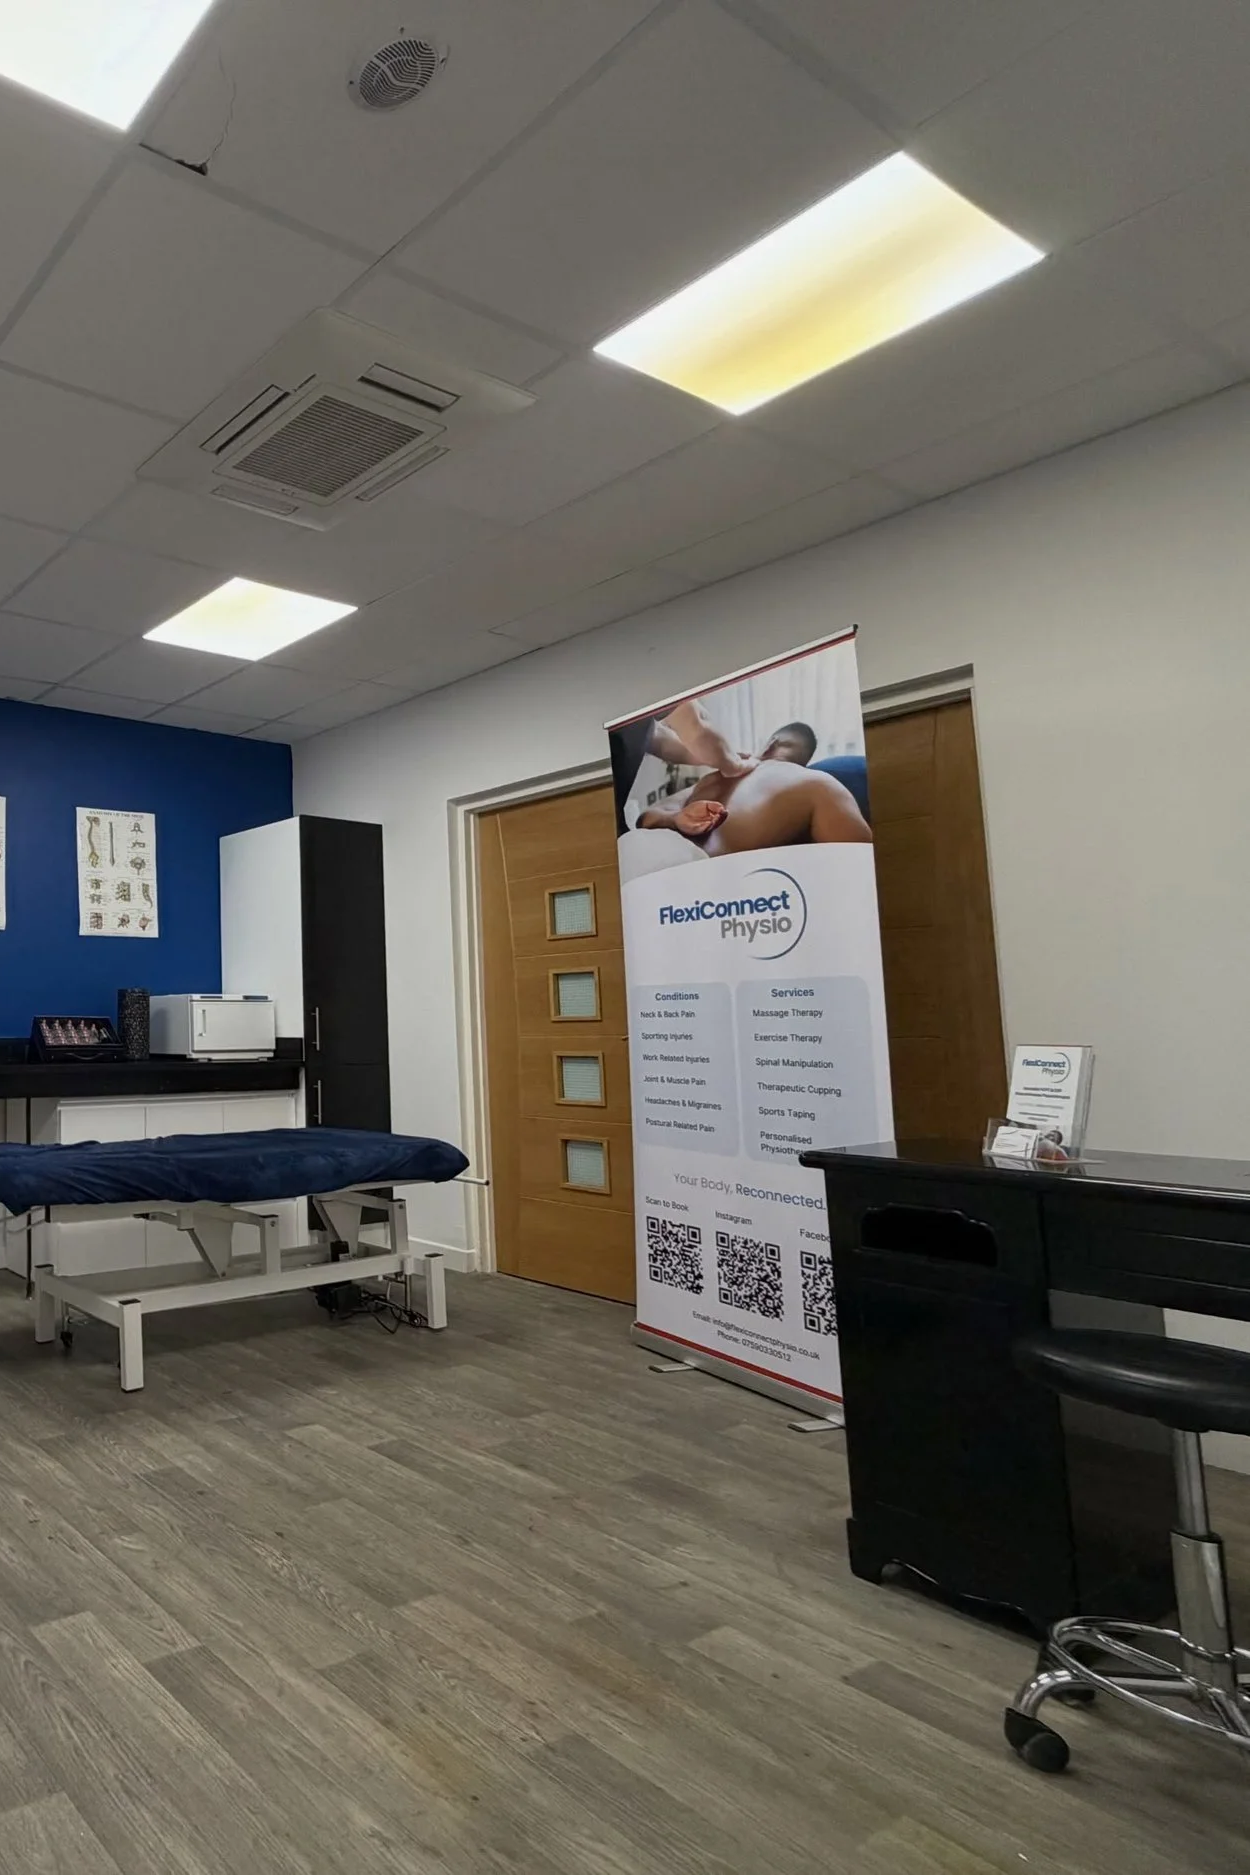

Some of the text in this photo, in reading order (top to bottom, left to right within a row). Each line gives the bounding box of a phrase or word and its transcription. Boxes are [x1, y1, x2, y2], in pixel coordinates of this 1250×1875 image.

[660, 890, 790, 924] FlexiConnect
[721, 912, 792, 943] Physio
[655, 992, 699, 1001] Conditions
[771, 988, 814, 997] Services
[752, 1009, 823, 1018] Massage Therapy
[641, 1032, 693, 1041] Sporting Injuries
[754, 1033, 822, 1044] Exercise Therapy
[686, 1055, 710, 1064] Injuries
[755, 1058, 833, 1069] Spinal Manipulation
[667, 1076, 690, 1085] Muscle
[758, 1082, 842, 1097] Therapeutic Cupping
[645, 1096, 680, 1107] Headaches
[688, 1100, 722, 1110] Migraines
[758, 1106, 816, 1121] Sports Taping
[646, 1118, 715, 1132] Postural Related Pain
[760, 1131, 812, 1144] Personalised
[761, 1144, 804, 1155] Physiothe
[674, 1173, 826, 1210] Your Body, Reconnected.
[646, 1196, 689, 1212] Scan to Book
[715, 1211, 752, 1225] Instagram
[800, 1228, 830, 1242] Facebo
[693, 1311, 711, 1323] Email:
[717, 1330, 741, 1344] Phone:
